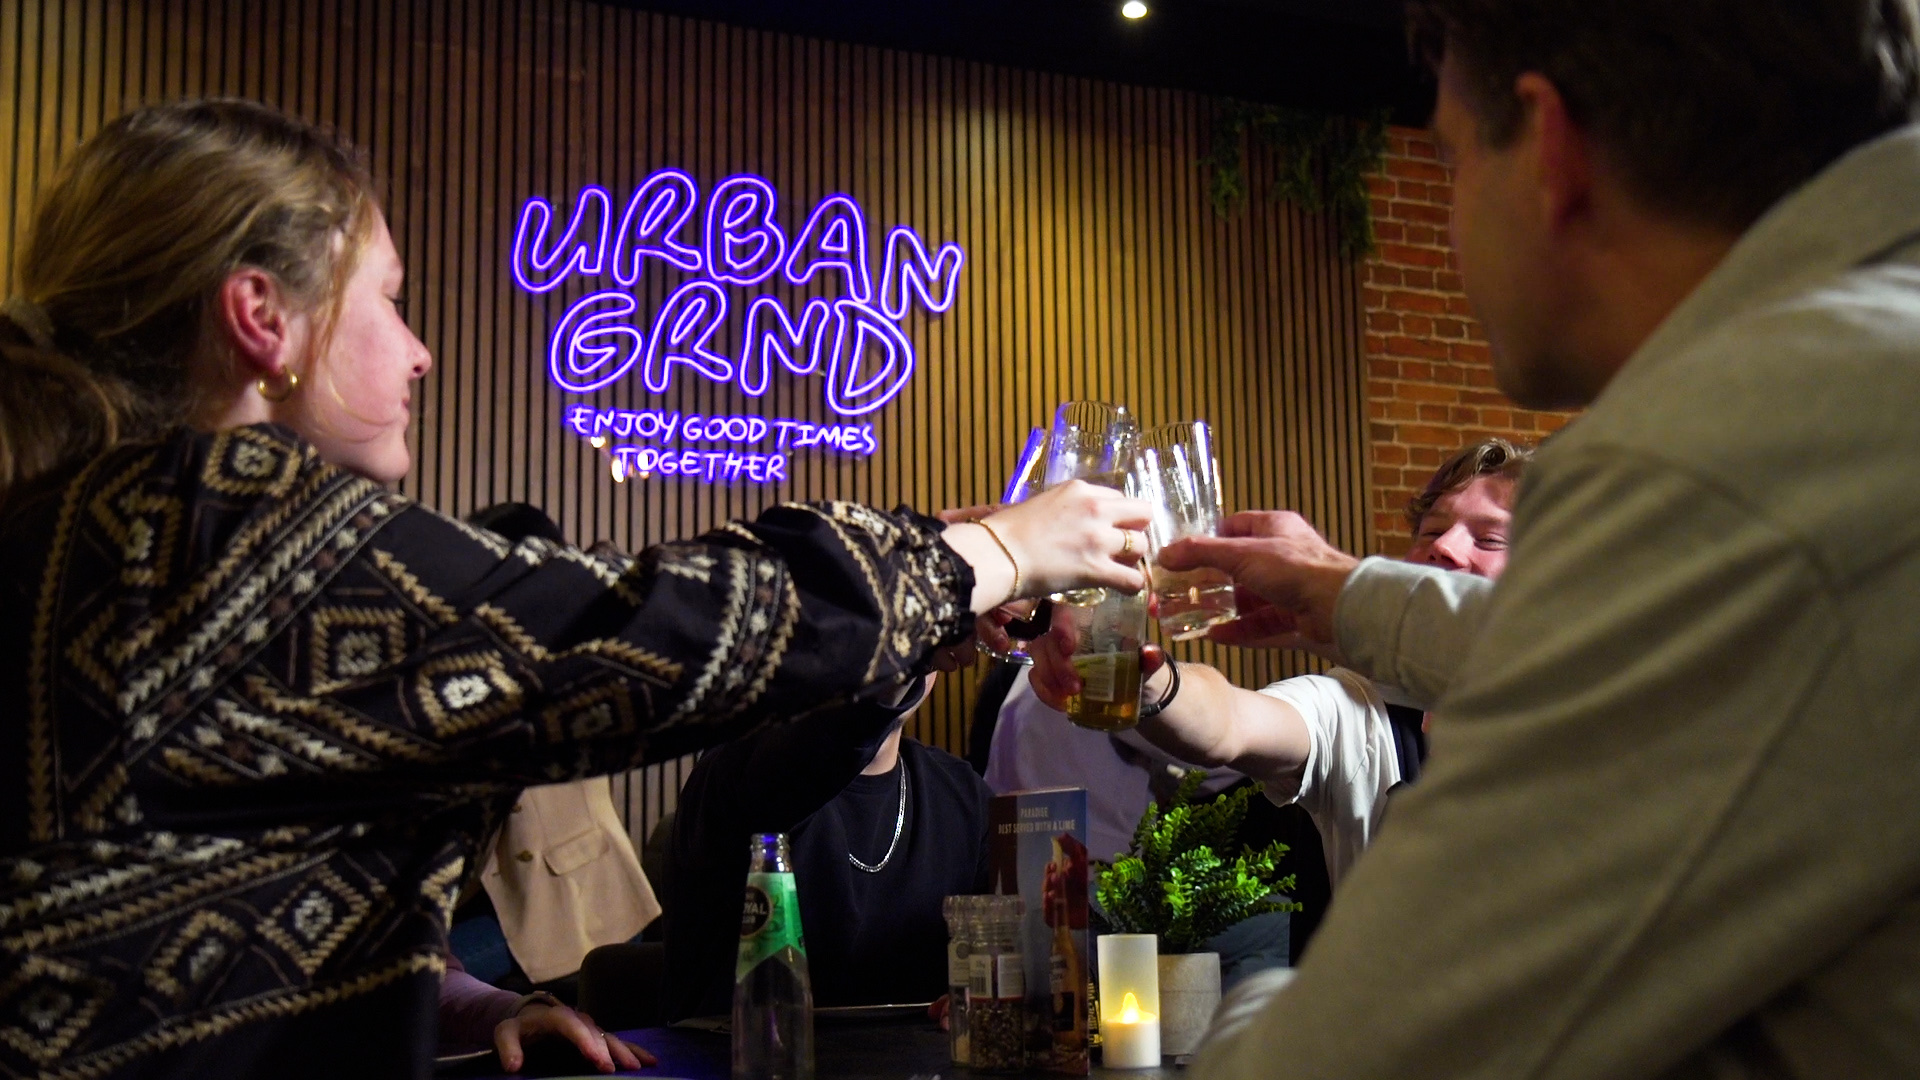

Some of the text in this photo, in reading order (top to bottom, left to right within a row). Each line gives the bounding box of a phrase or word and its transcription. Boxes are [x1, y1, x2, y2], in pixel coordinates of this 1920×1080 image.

[512, 169, 965, 321] URBAN
[549, 279, 915, 417] GRND
[567, 406, 877, 455] ENJOY GOOD TIMES
[613, 446, 787, 482] TOGETHER
[1013, 821, 1034, 834] SERVED
[1034, 820, 1051, 832] WITH
[1058, 819, 1075, 831] LIME
[1020, 806, 1049, 818] PARADISE
